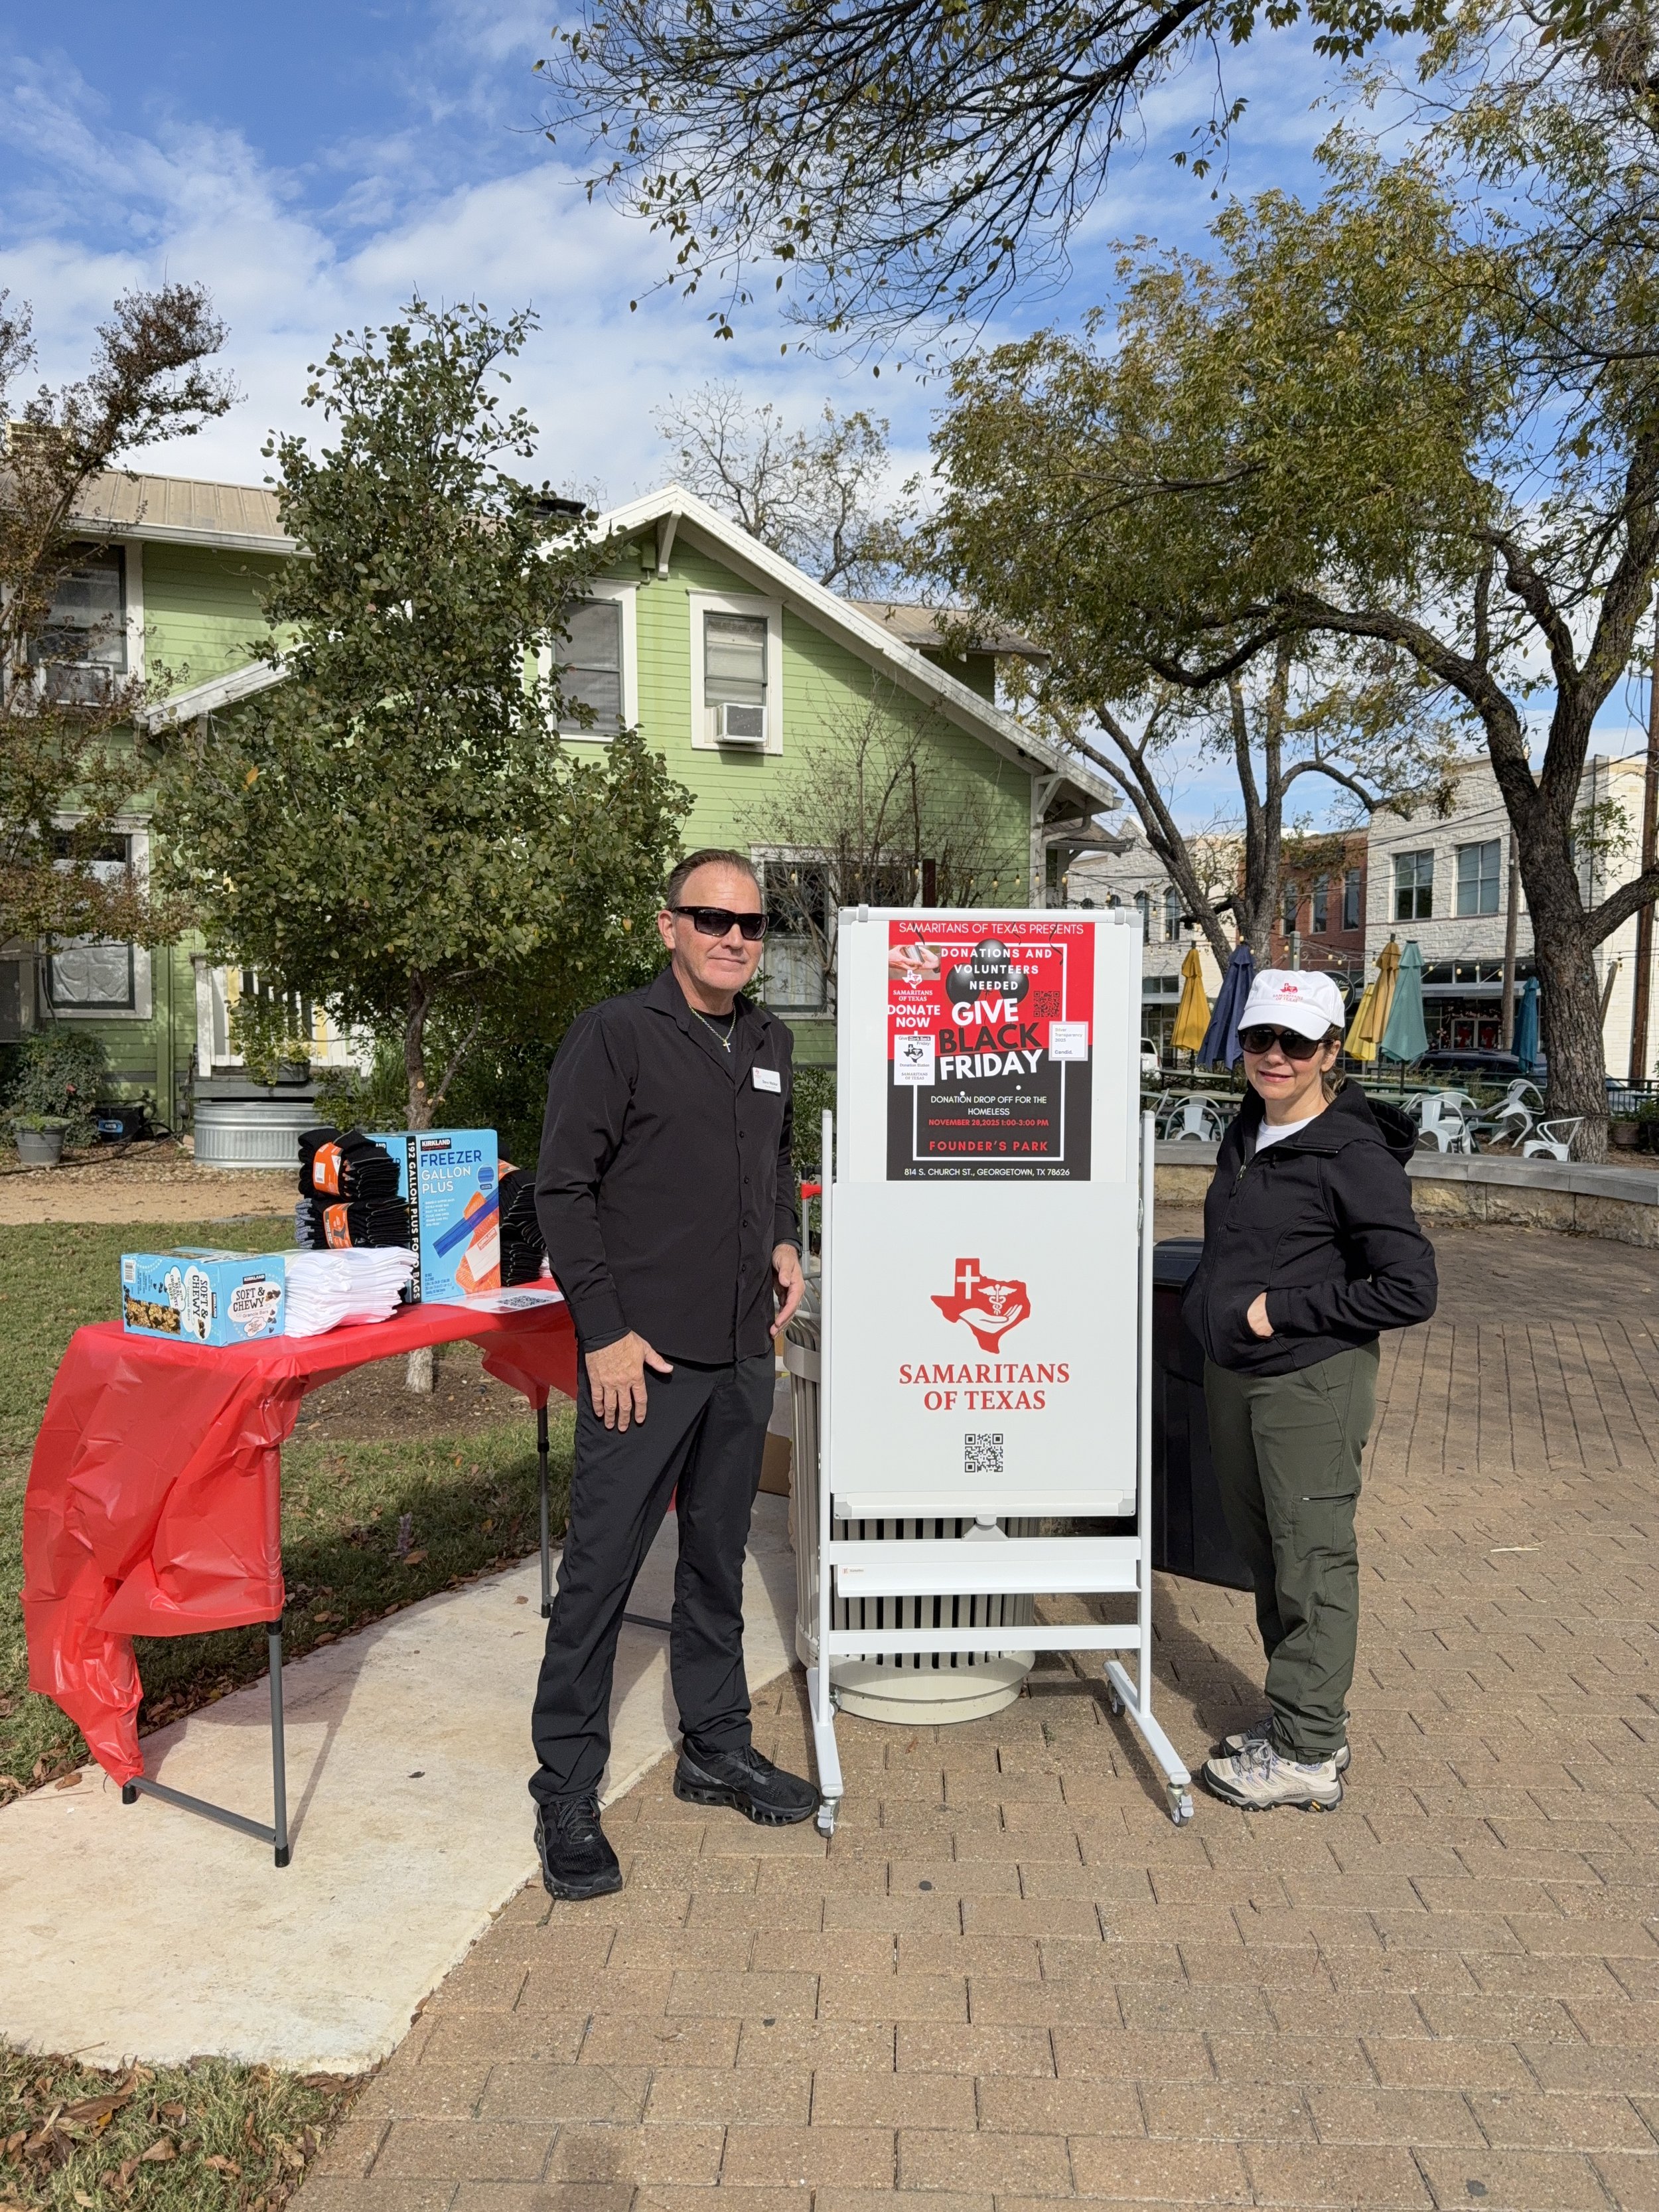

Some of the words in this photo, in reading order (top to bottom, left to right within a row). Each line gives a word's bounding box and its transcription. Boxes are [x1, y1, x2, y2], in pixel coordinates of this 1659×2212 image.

[899, 922, 970, 933] SAMARITANS
[972, 923, 990, 933] OF
[991, 923, 1027, 934] TEXAS
[1029, 924, 1084, 934] PRESENTS
[941, 948, 1019, 958] DONATIONS
[1025, 949, 1052, 958] AND
[954, 964, 1039, 974] VOLUNTEERS
[970, 981, 1018, 990] NEEDED
[887, 1004, 941, 1015] DONATE
[952, 997, 1019, 1026] GIVE
[896, 1017, 930, 1027] NOW
[938, 1022, 1043, 1054] BLACK
[939, 1049, 1044, 1081] FRIDAY
[929, 1141, 1007, 1151] FOUNDER'S
[1013, 1142, 1048, 1151] PARK
[421, 1149, 482, 1167] FREEZER
[421, 1165, 471, 1181] GALLON
[977, 1168, 1035, 1177] GEORGETOWN,
[409, 1162, 417, 1204] GALLON
[422, 1181, 454, 1194] PLUS
[170, 1274, 179, 1307] CHOCOLATE
[236, 1288, 256, 1301] SOFT
[257, 1286, 265, 1296] &
[233, 1297, 265, 1312] CHEWY
[200, 1308, 208, 1319] &
[899, 1363, 1070, 1384] SAMARITANS
[924, 1391, 958, 1410] OF
[964, 1390, 1046, 1410] TEXAS
